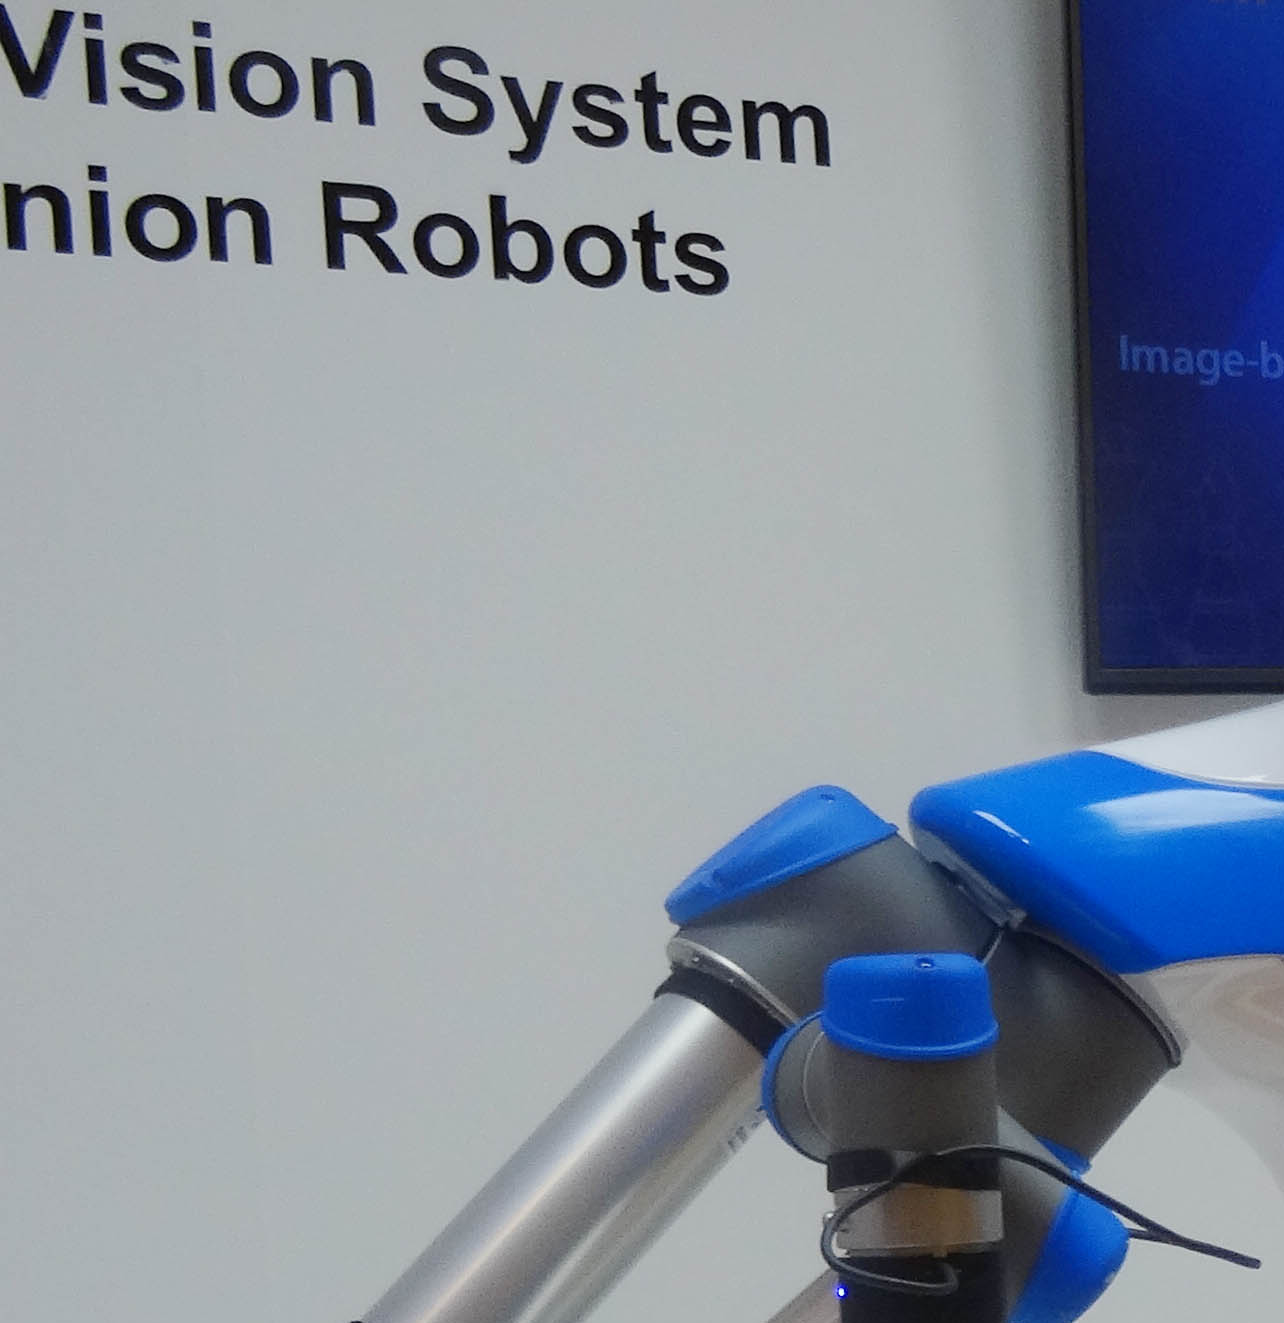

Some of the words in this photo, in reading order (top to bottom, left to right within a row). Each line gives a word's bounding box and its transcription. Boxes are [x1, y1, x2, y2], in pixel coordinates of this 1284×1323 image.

[0, 4, 377, 127] Vision
[421, 45, 833, 167] System
[2, 164, 273, 266] nion
[321, 180, 731, 297] Robots
